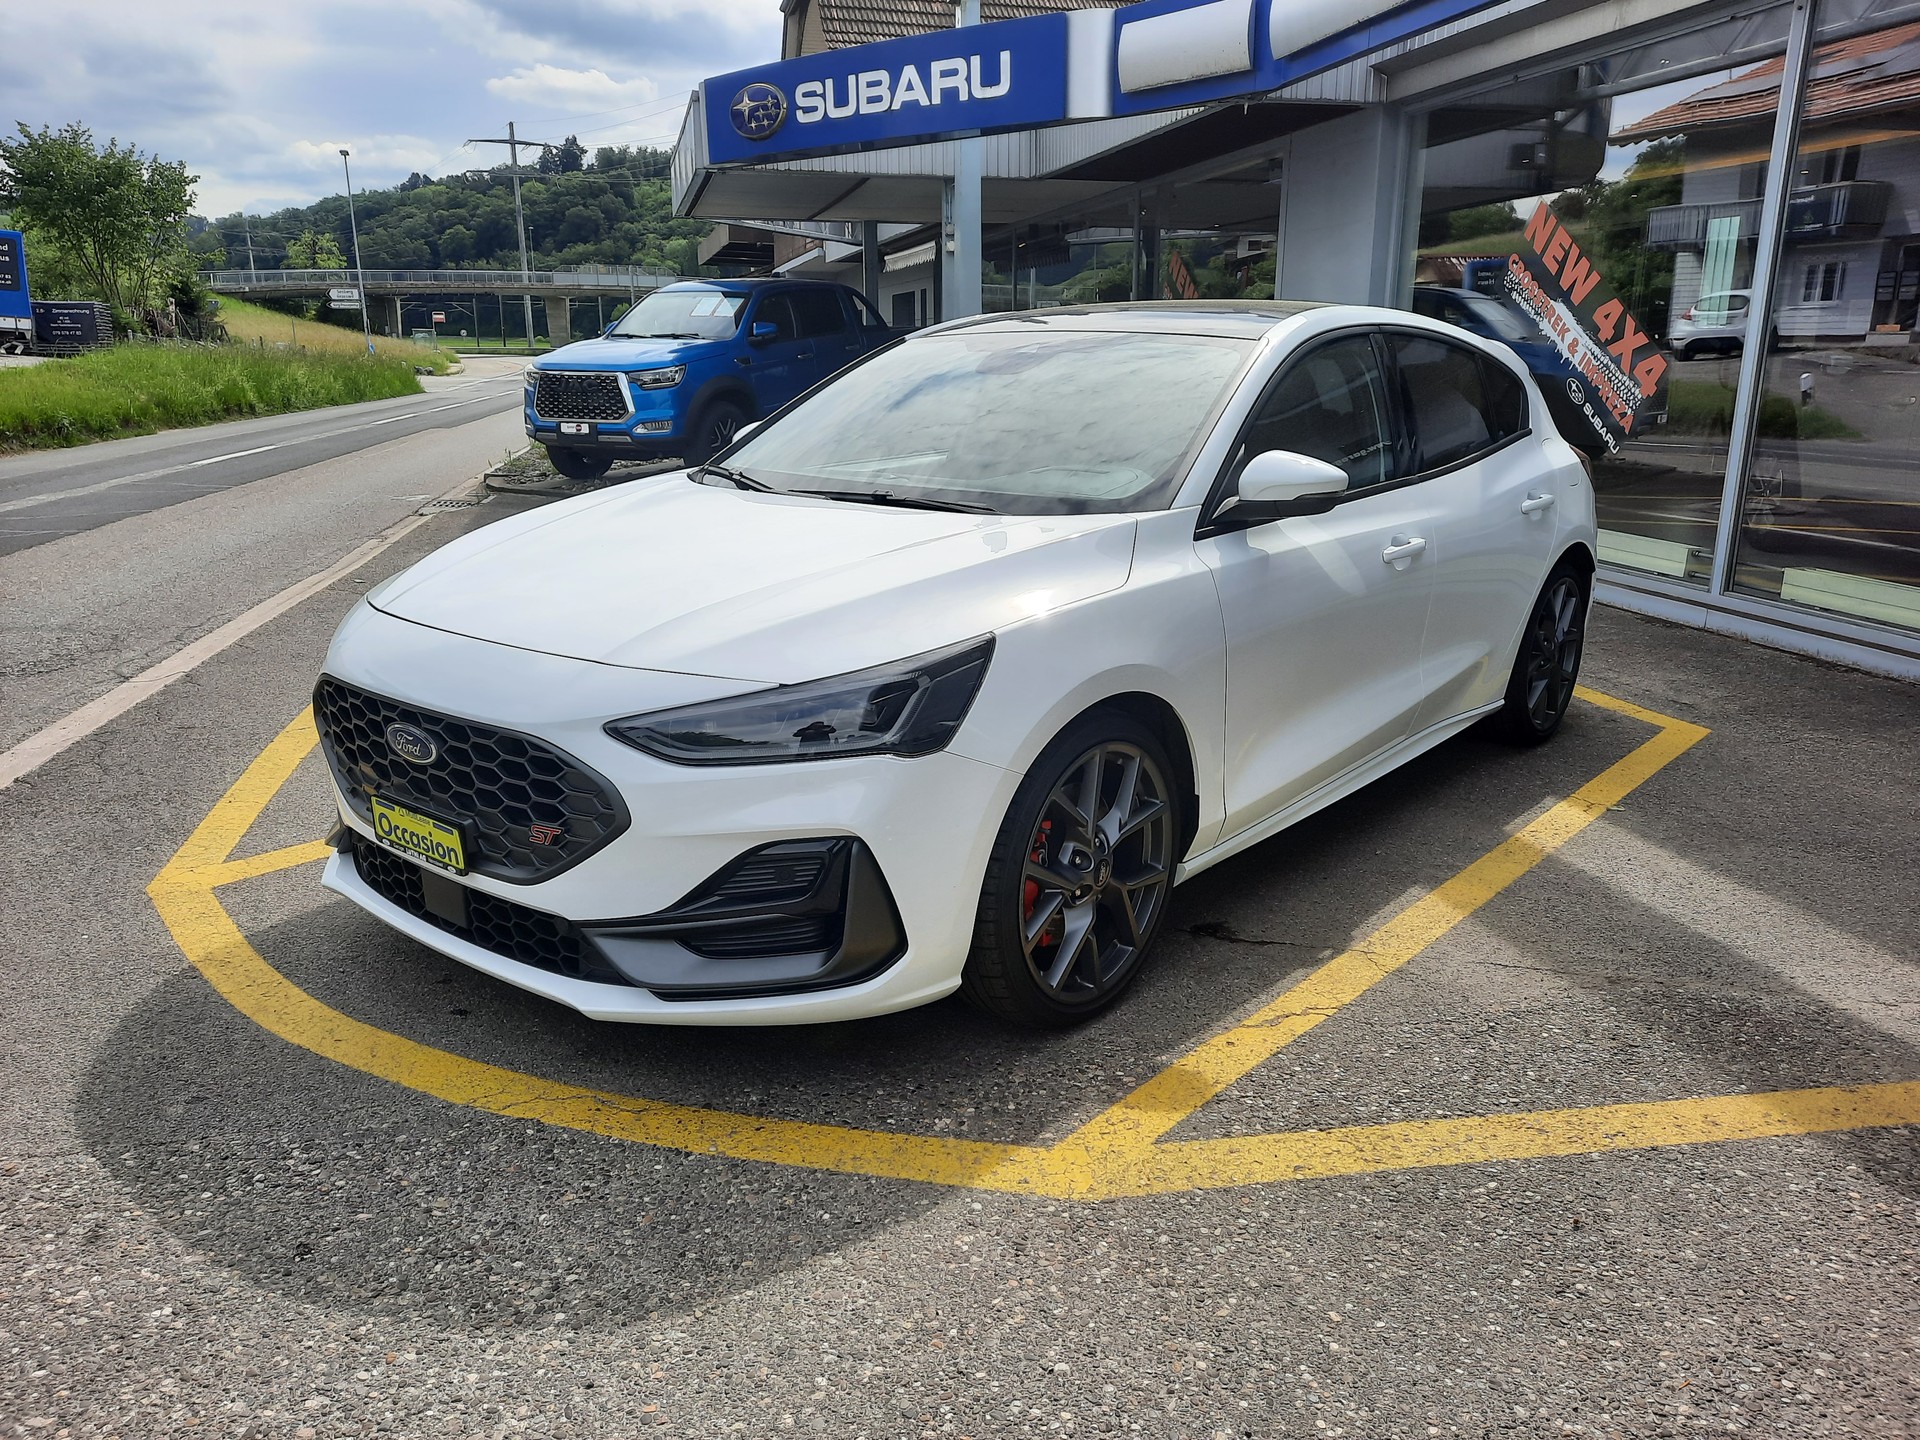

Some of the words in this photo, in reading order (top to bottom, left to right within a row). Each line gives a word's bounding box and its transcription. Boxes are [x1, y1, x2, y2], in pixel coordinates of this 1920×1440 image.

[795, 50, 1012, 124] SUBARU
[1524, 200, 1601, 307] NEW
[1592, 297, 1669, 399] 4X4
[1508, 253, 1573, 345] CROSSTREK
[1567, 338, 1580, 358] &
[1577, 351, 1636, 436] IMPREZA
[1583, 402, 1620, 454] SUBARU
[396, 732, 422, 757] Ford
[378, 812, 460, 866] Occasion
[529, 825, 563, 846] ST
